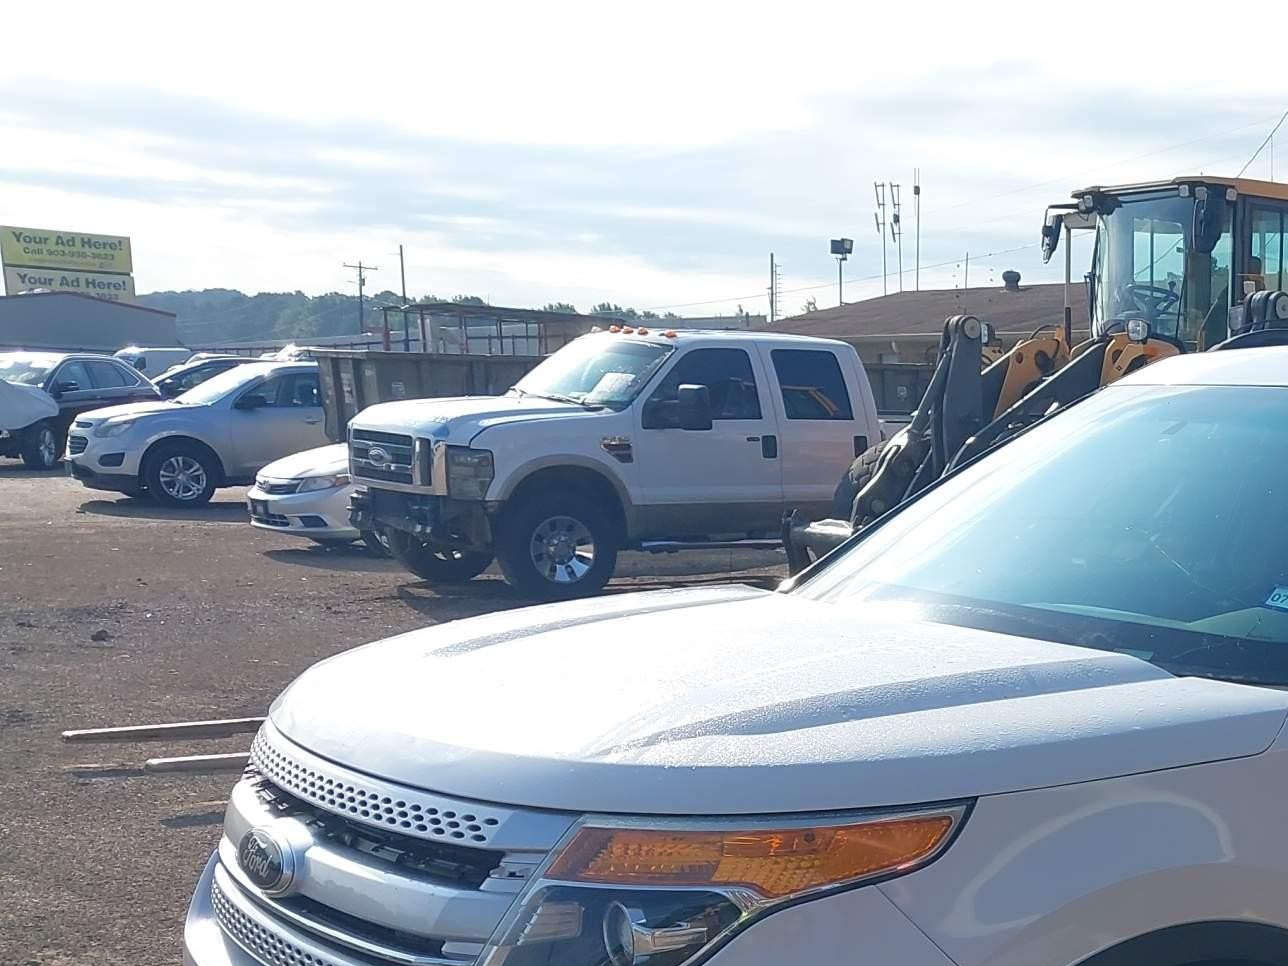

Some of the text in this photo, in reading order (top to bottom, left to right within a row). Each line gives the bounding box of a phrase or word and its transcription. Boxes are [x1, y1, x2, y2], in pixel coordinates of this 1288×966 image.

[12, 231, 123, 251] Your Ad Here!
[23, 247, 44, 255] Call
[17, 272, 127, 291] Your Ad Here!
[243, 836, 273, 878] Ford
